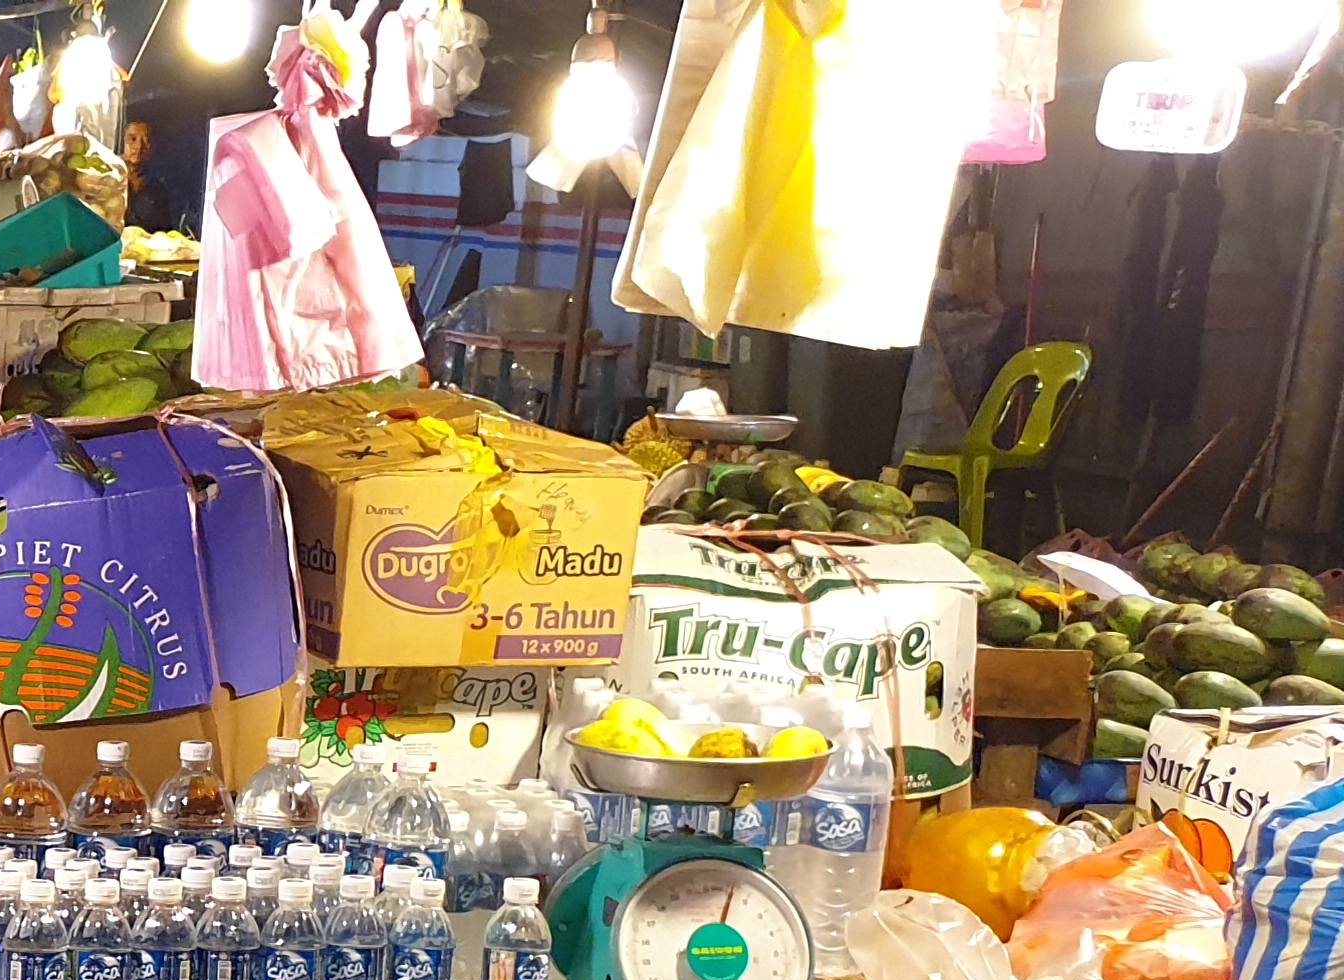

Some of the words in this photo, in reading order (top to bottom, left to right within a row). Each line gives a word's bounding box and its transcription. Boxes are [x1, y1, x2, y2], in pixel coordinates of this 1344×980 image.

[298, 539, 337, 575] adu
[377, 551, 469, 583] Dugro
[535, 544, 623, 577] Madu
[100, 559, 188, 681] CITRUS
[469, 602, 523, 630] 3-6
[530, 601, 616, 630] Tahun
[553, 639, 585, 654] 900
[648, 603, 932, 702] Tru-Cape
[681, 665, 733, 677] SOUTH
[739, 669, 796, 687] AFRICA
[815, 816, 862, 841] Sasa
